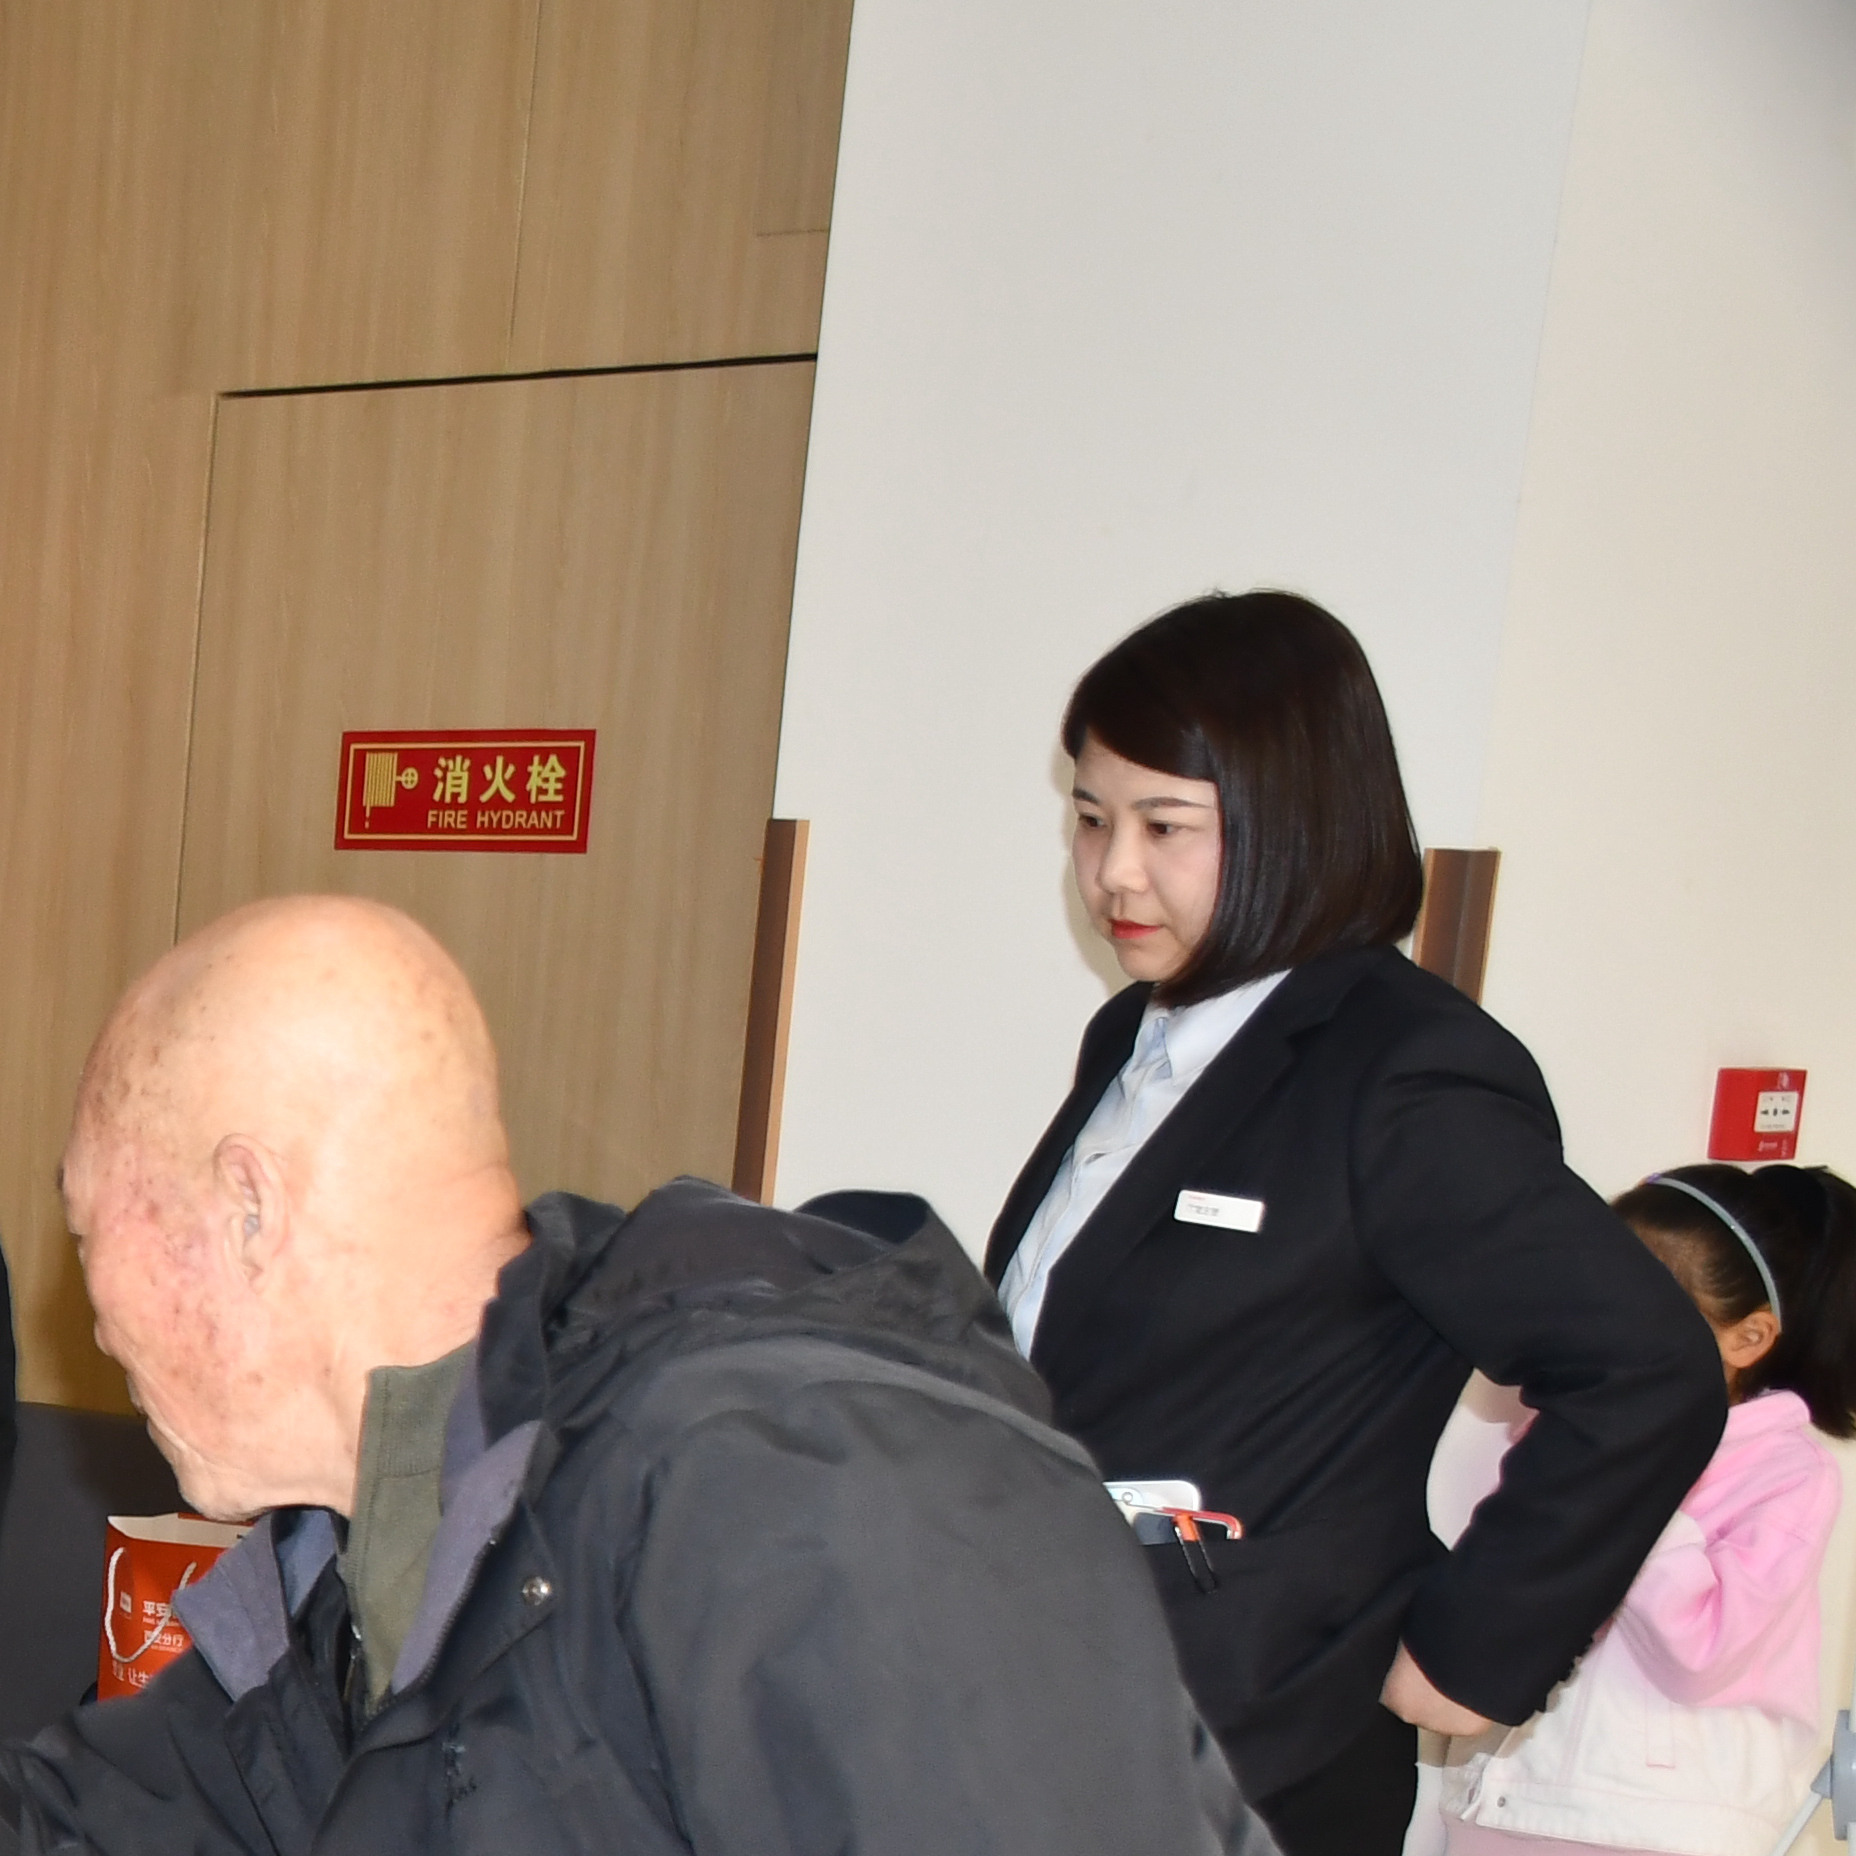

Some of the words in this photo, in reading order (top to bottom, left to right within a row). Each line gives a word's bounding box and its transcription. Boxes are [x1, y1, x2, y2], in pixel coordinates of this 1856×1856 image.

[432, 754, 567, 804] 消火栓
[427, 809, 468, 829] FIRE
[476, 809, 566, 829] HYDRANT
